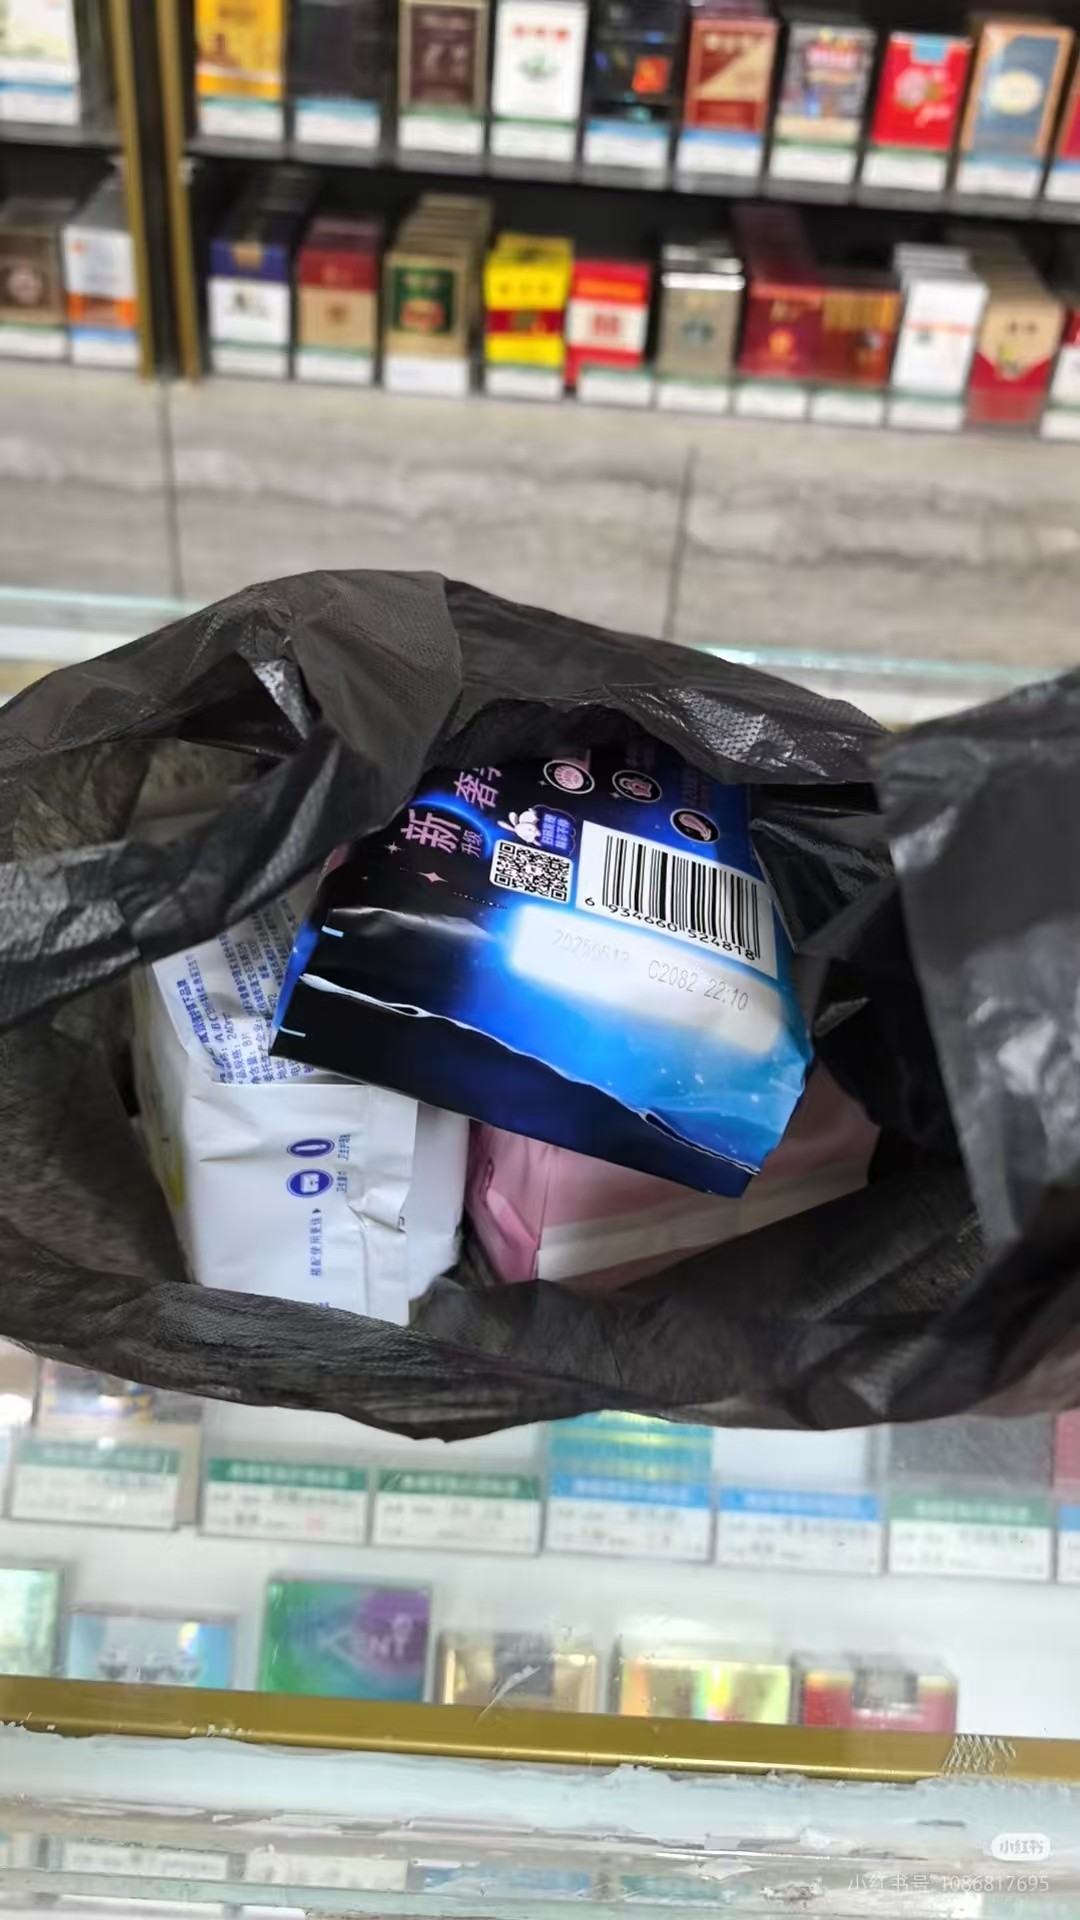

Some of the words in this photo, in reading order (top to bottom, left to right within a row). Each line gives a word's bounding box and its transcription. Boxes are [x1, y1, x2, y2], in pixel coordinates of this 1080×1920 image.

[400, 809, 461, 853] 新
[461, 829, 484, 858] 升级
[584, 896, 596, 907] 6
[608, 903, 679, 933] 934660
[687, 928, 756, 961] 524818
[648, 959, 699, 993] C2082
[703, 977, 749, 1011] 22:10
